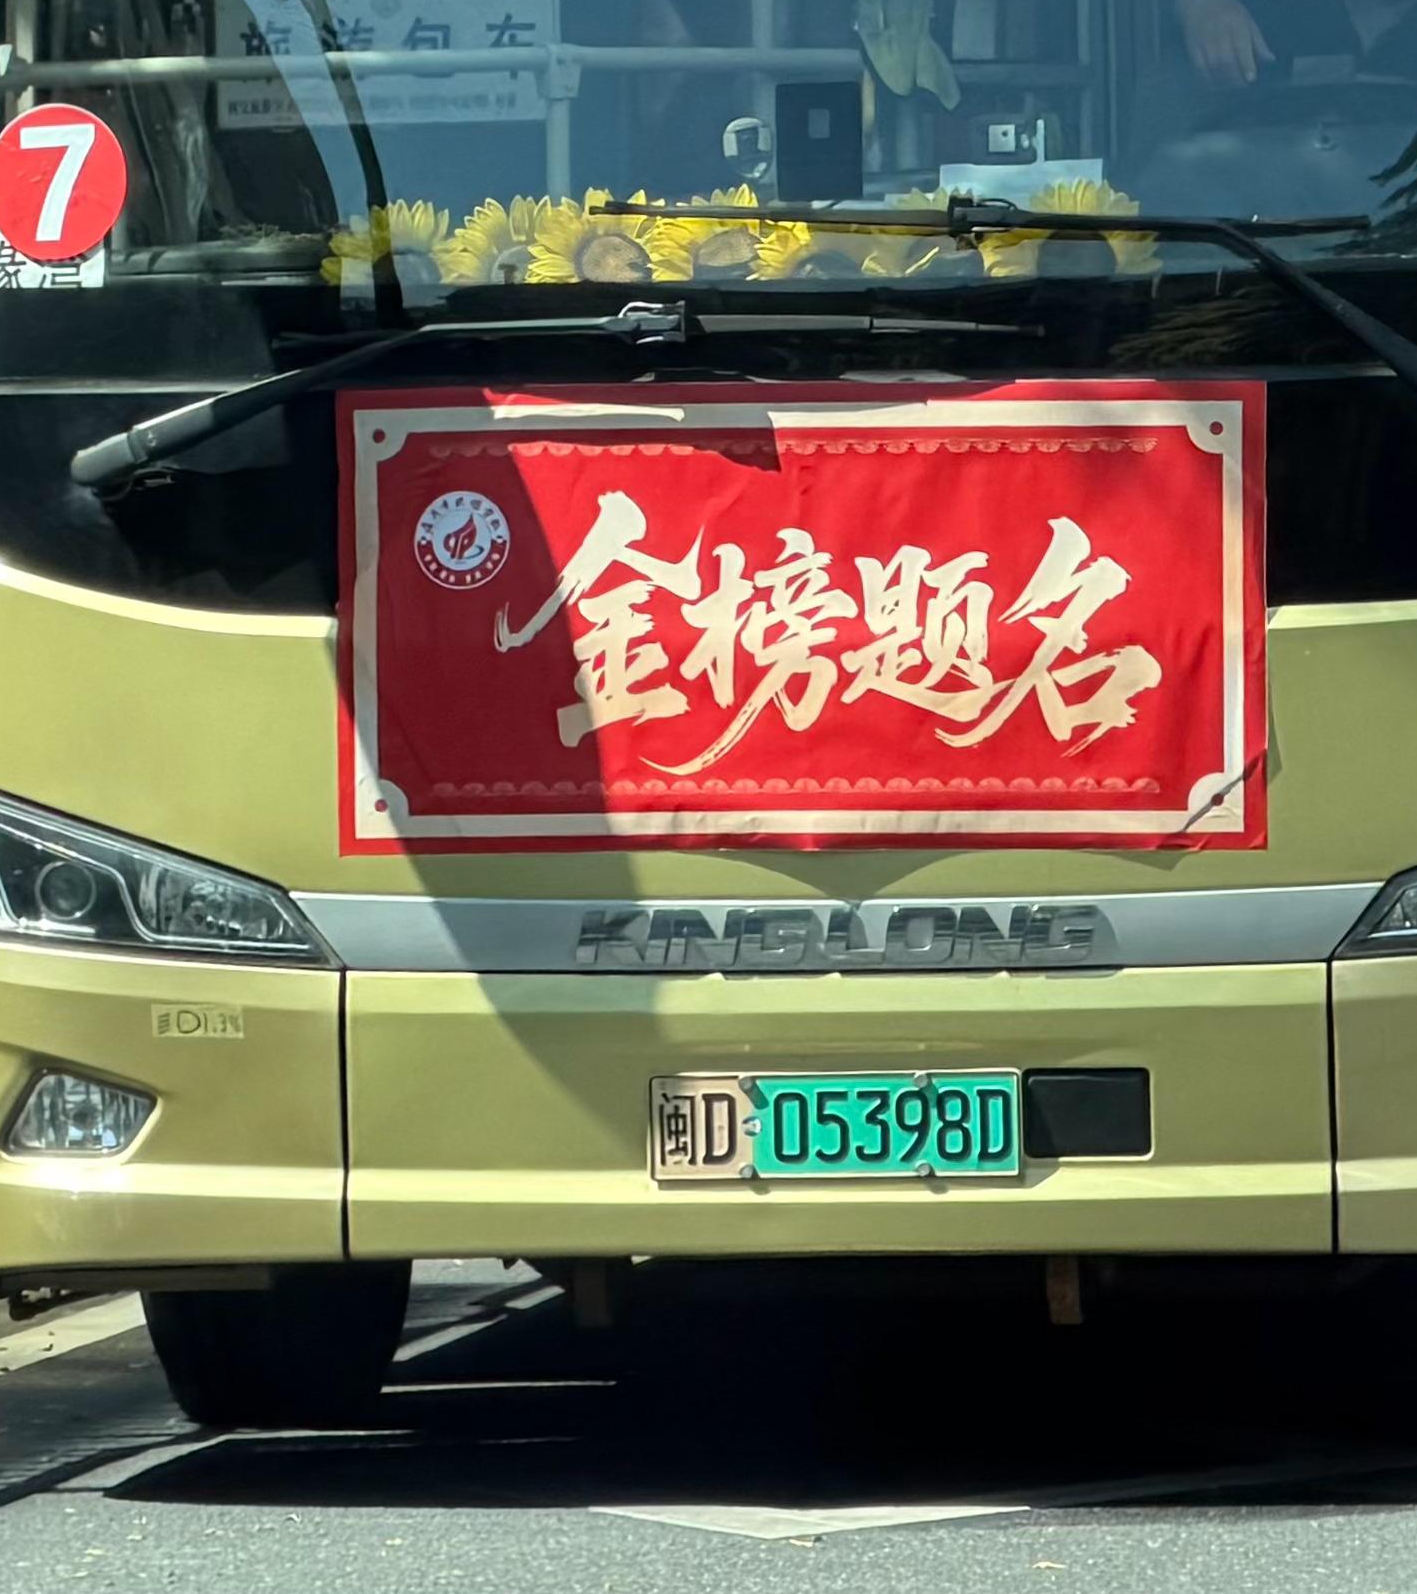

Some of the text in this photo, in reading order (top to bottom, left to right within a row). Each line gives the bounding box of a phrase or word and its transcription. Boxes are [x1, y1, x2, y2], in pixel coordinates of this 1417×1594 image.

[19, 123, 97, 243] 7
[494, 489, 1163, 776] 金榜题名
[575, 905, 1101, 965] KINGLONG
[772, 1088, 1013, 1164] 05398D
